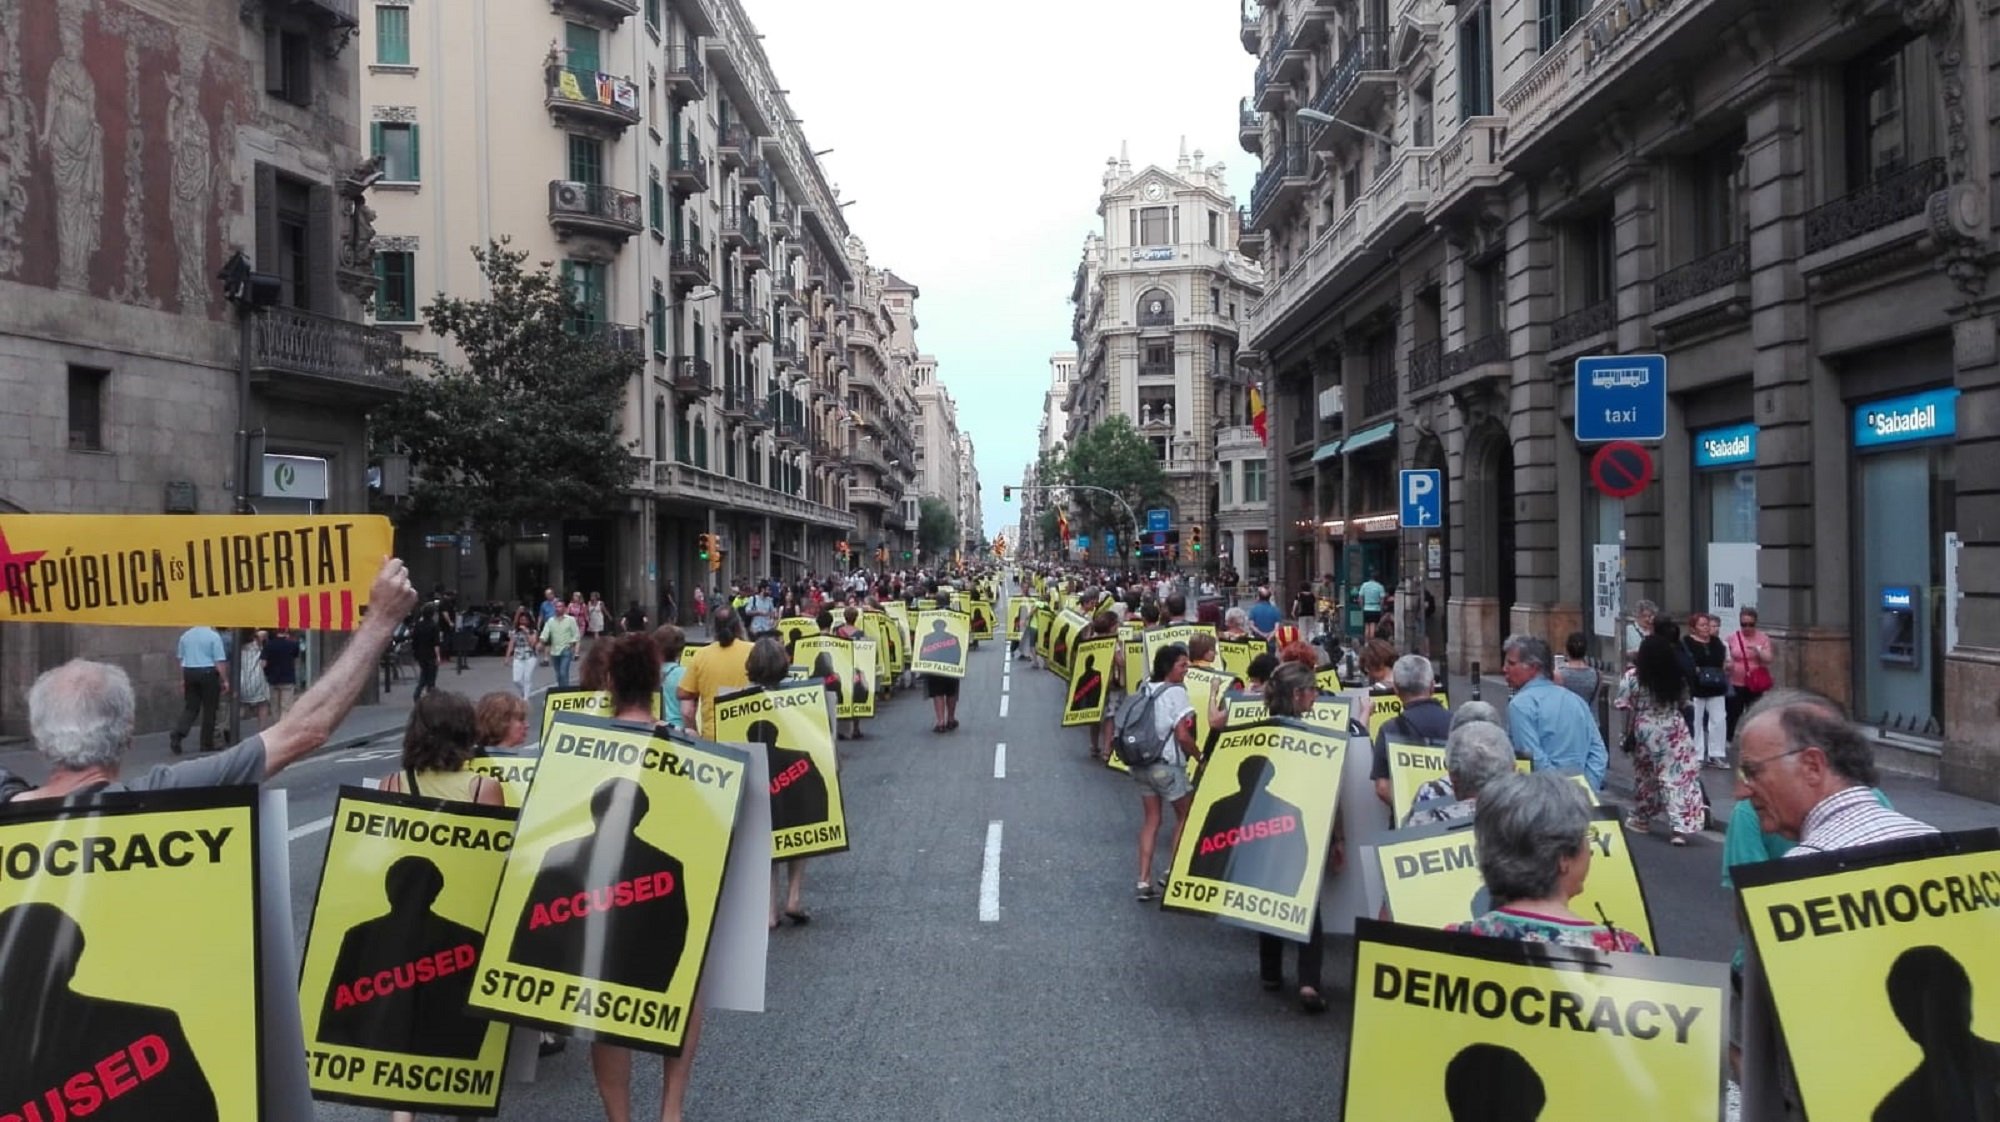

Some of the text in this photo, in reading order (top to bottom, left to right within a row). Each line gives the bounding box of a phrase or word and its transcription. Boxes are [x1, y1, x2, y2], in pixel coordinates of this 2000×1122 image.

[1605, 406, 1637, 422] taxi
[1876, 404, 1935, 435] Sabadell
[1709, 435, 1750, 457] Sabadell
[1408, 474, 1434, 505] P
[4, 546, 169, 615] REPÚBLICA
[186, 523, 353, 599] LLIBERTAT
[720, 691, 819, 721] DEMOCRACY
[555, 733, 733, 789] DEMOCRACY
[1220, 733, 1338, 759] DEMOCRACY
[0, 827, 234, 882] OCRACY
[775, 825, 841, 850] FASCISM
[1200, 815, 1297, 855] ACCUSED
[529, 871, 674, 930] ACCUSED
[1172, 881, 1308, 925] STOP FASCISM
[334, 944, 475, 1010] ACCUSED
[481, 969, 681, 1032] STOP FASCISM
[1373, 962, 1703, 1044] DEMOCRACY
[0, 1034, 171, 1122] USED
[373, 1060, 494, 1095] FASCISM
